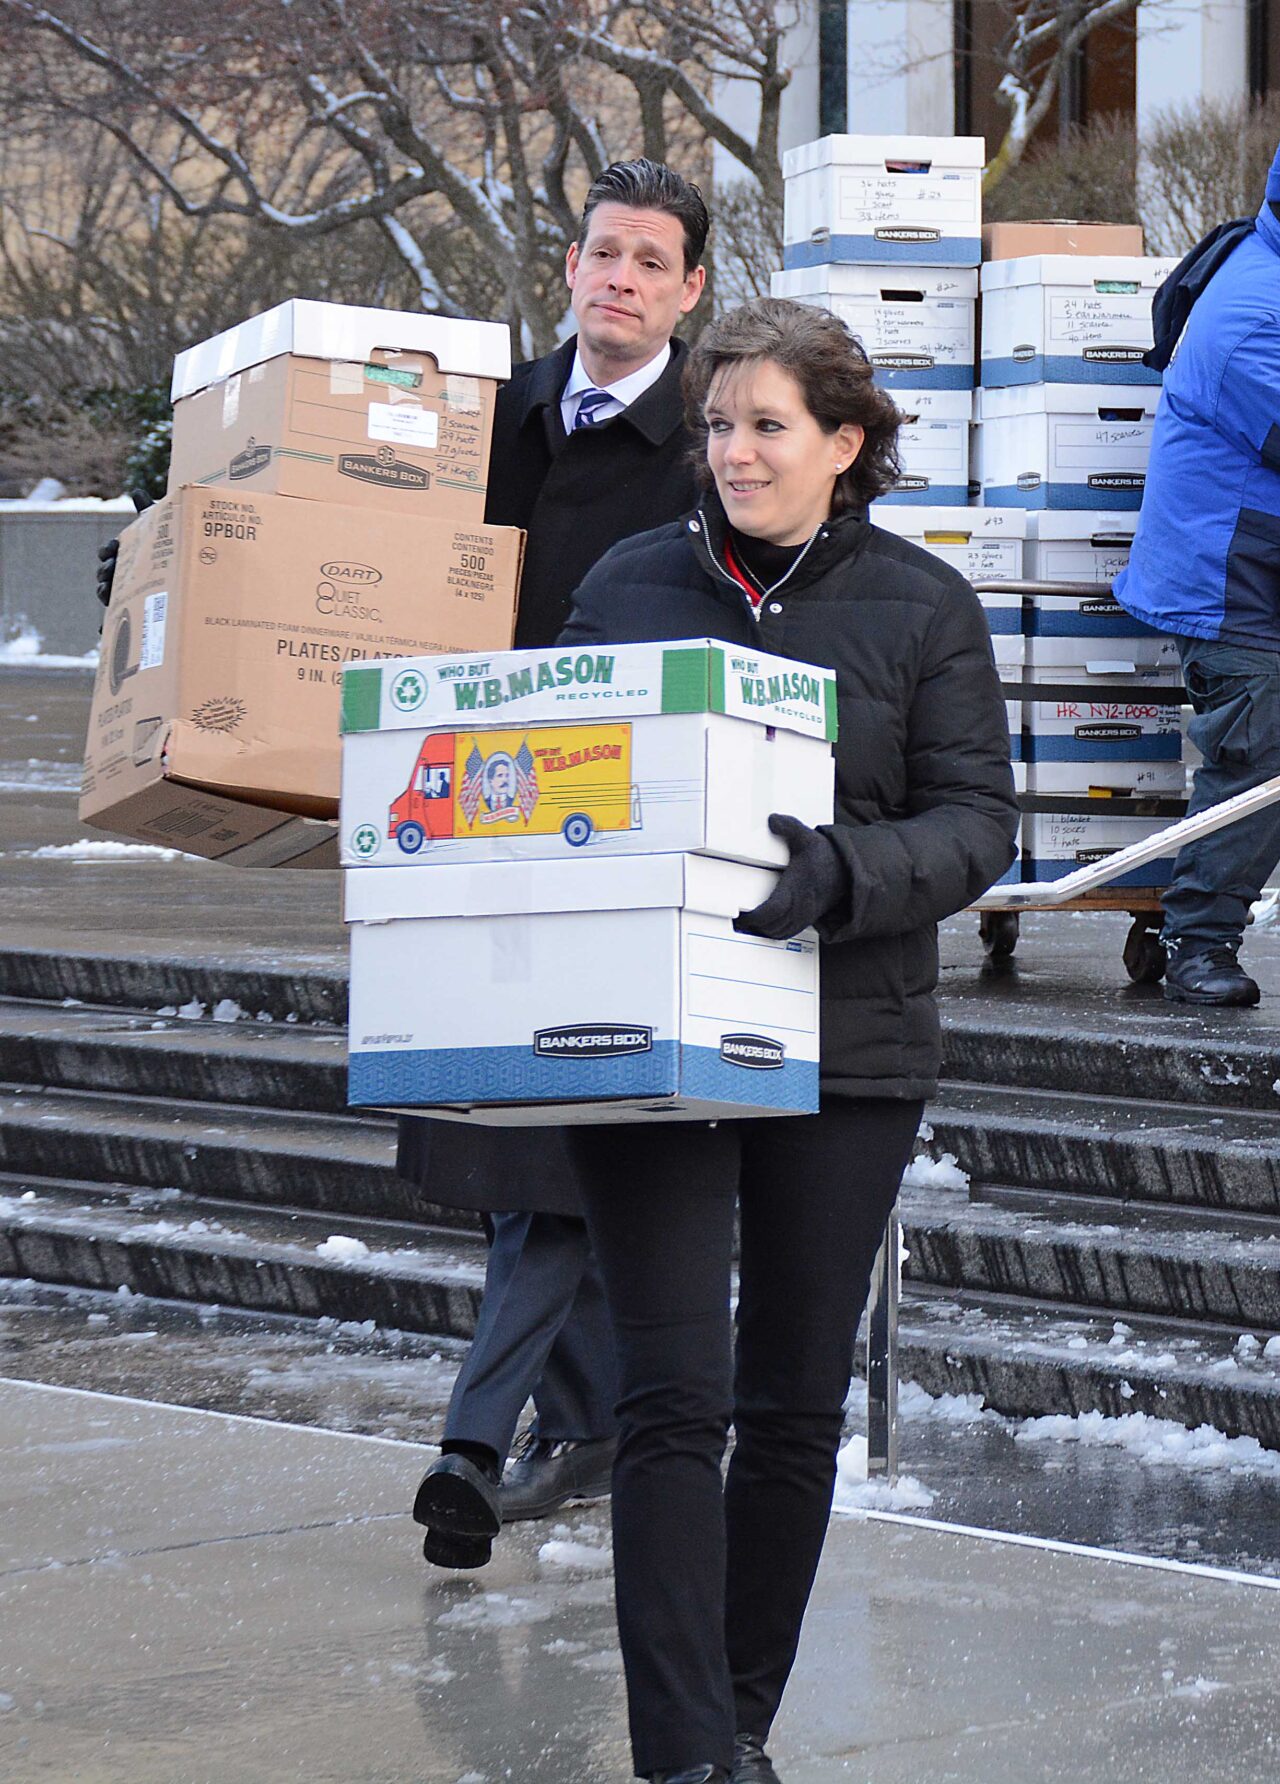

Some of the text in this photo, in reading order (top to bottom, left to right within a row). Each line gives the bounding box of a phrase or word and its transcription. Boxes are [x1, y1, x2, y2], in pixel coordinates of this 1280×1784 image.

[877, 230, 938, 239] BANKERS BOX
[872, 357, 932, 368] BANKERS BOX
[1086, 350, 1127, 360] BANKERS
[343, 459, 424, 485] BANKERS BOX
[907, 479, 926, 488] BOX
[1091, 478, 1145, 487] BANKERS BO
[209, 500, 240, 512] STOCK
[204, 522, 257, 541] 9PBQR
[454, 532, 494, 546] CONTENTS
[451, 542, 495, 556] CONTENIDO
[460, 553, 486, 571] 500
[327, 565, 375, 580] DART
[316, 581, 361, 604] QUIET
[204, 616, 231, 627] BLACK
[231, 618, 277, 630] LAMINATED
[277, 622, 300, 633] FOAM
[301, 625, 351, 638] DINNERWARE
[419, 641, 443, 652] NEGRA
[297, 667, 305, 681] 9
[309, 668, 327, 684] IN.
[437, 662, 491, 680] WHO BUT
[556, 688, 649, 702] RECYCLED
[773, 705, 823, 724] RECYCLED
[1056, 703, 1082, 718] HR
[1078, 728, 1139, 737] BANKERS BOX
[539, 1033, 647, 1049] BANKERS BOX
[723, 1042, 782, 1061] BANKERS BOX
